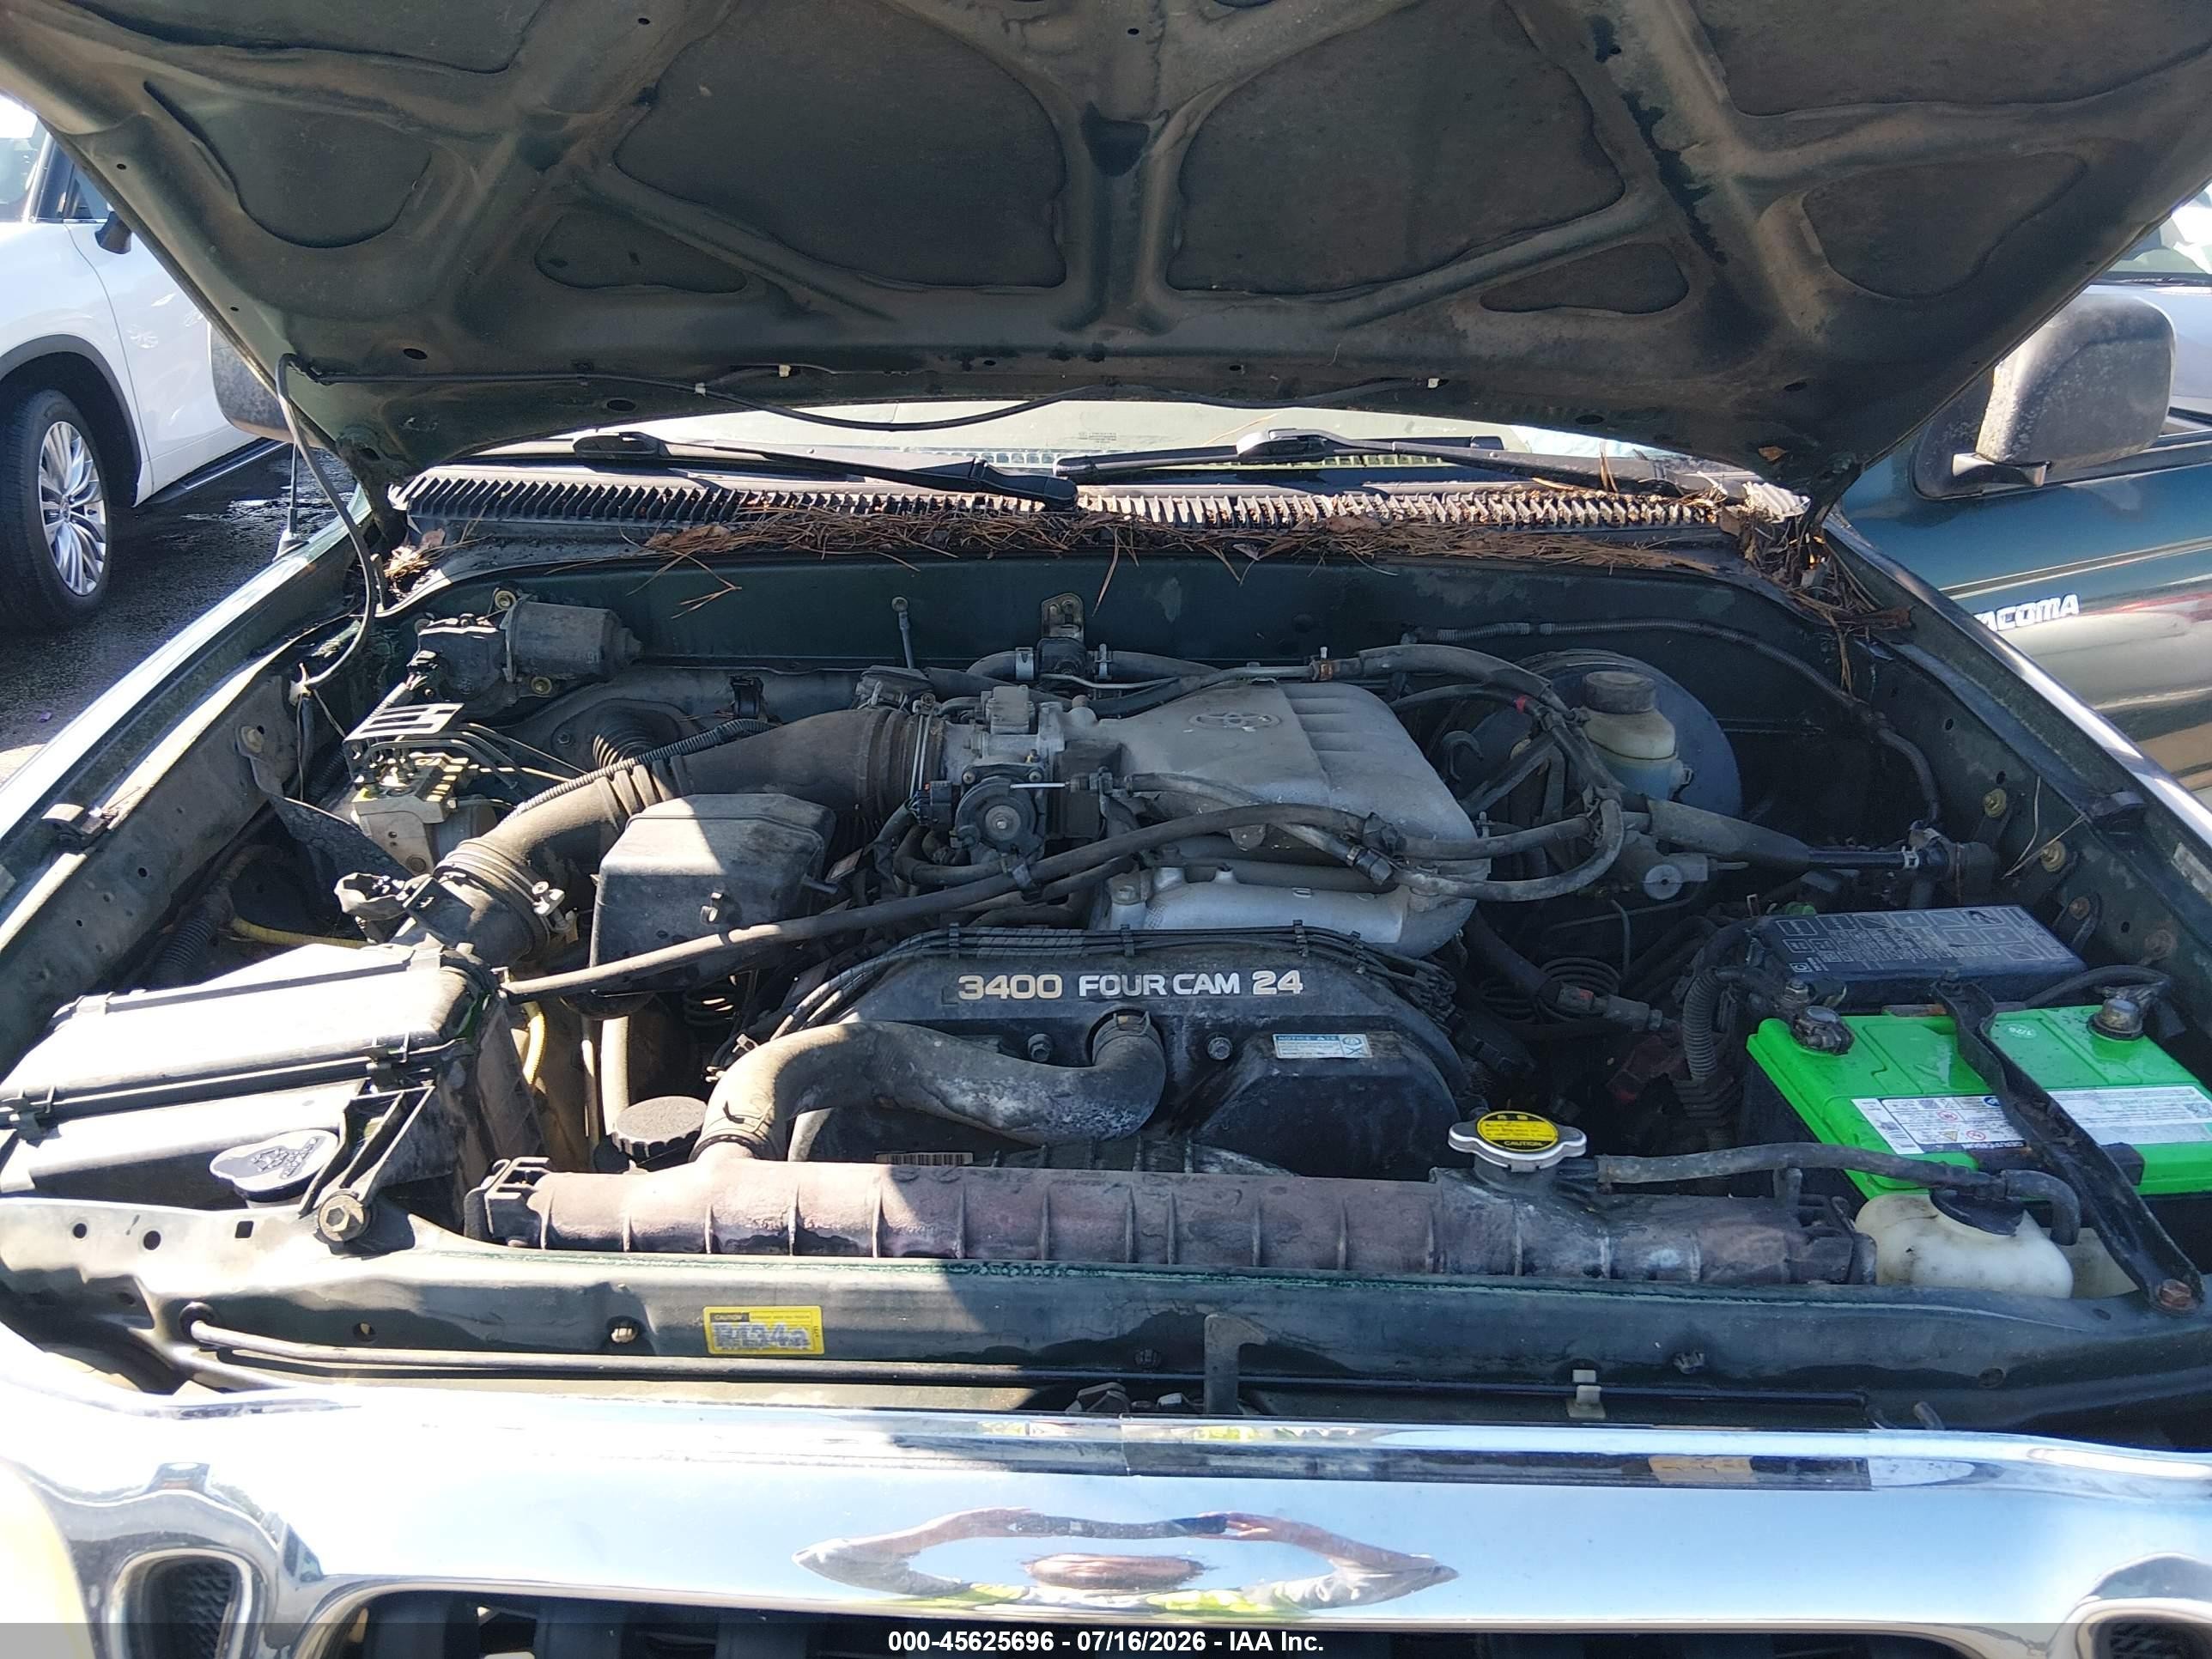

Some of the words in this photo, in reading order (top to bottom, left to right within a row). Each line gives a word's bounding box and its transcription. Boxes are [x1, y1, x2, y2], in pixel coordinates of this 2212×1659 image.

[1972, 593, 2079, 631] ACOMA
[958, 974, 1062, 1000] 3400
[1078, 975, 1168, 998] FOUR
[1172, 972, 1241, 996] CAM
[1251, 970, 1304, 996] 24
[713, 1322, 811, 1348] R134a
